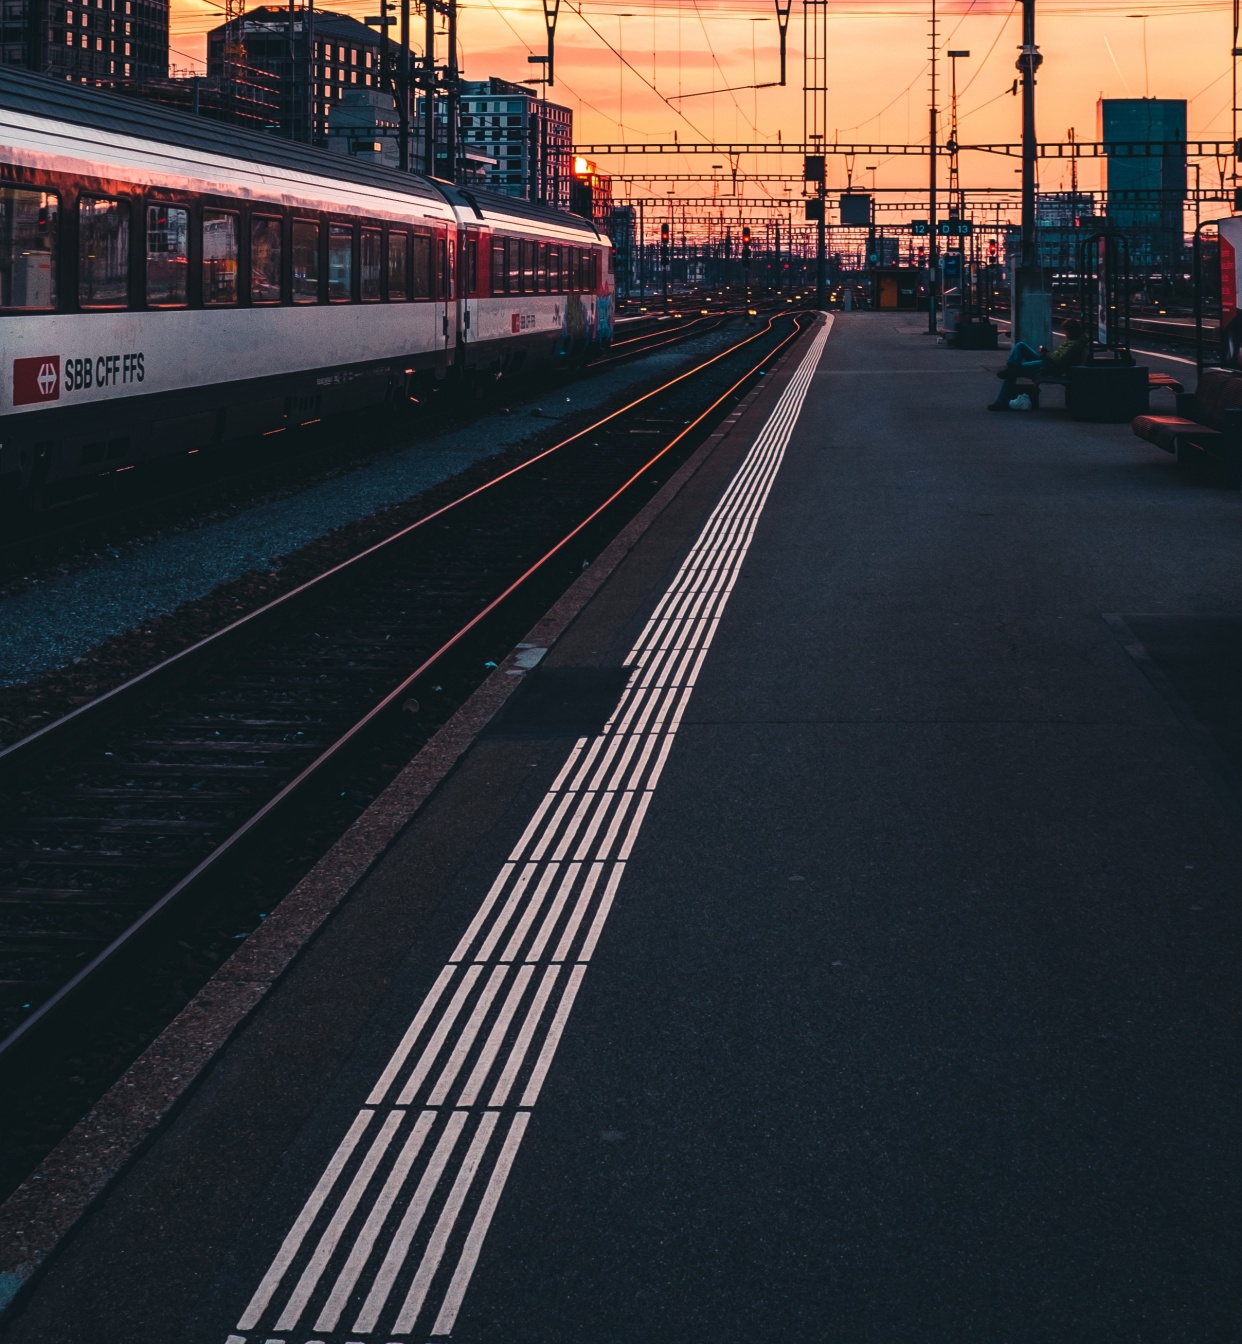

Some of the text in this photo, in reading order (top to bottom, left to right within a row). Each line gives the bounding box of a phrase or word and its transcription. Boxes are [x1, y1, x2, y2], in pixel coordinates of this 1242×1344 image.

[915, 225, 968, 233] 12 D 13
[65, 352, 144, 391] SBB CFF FFS
